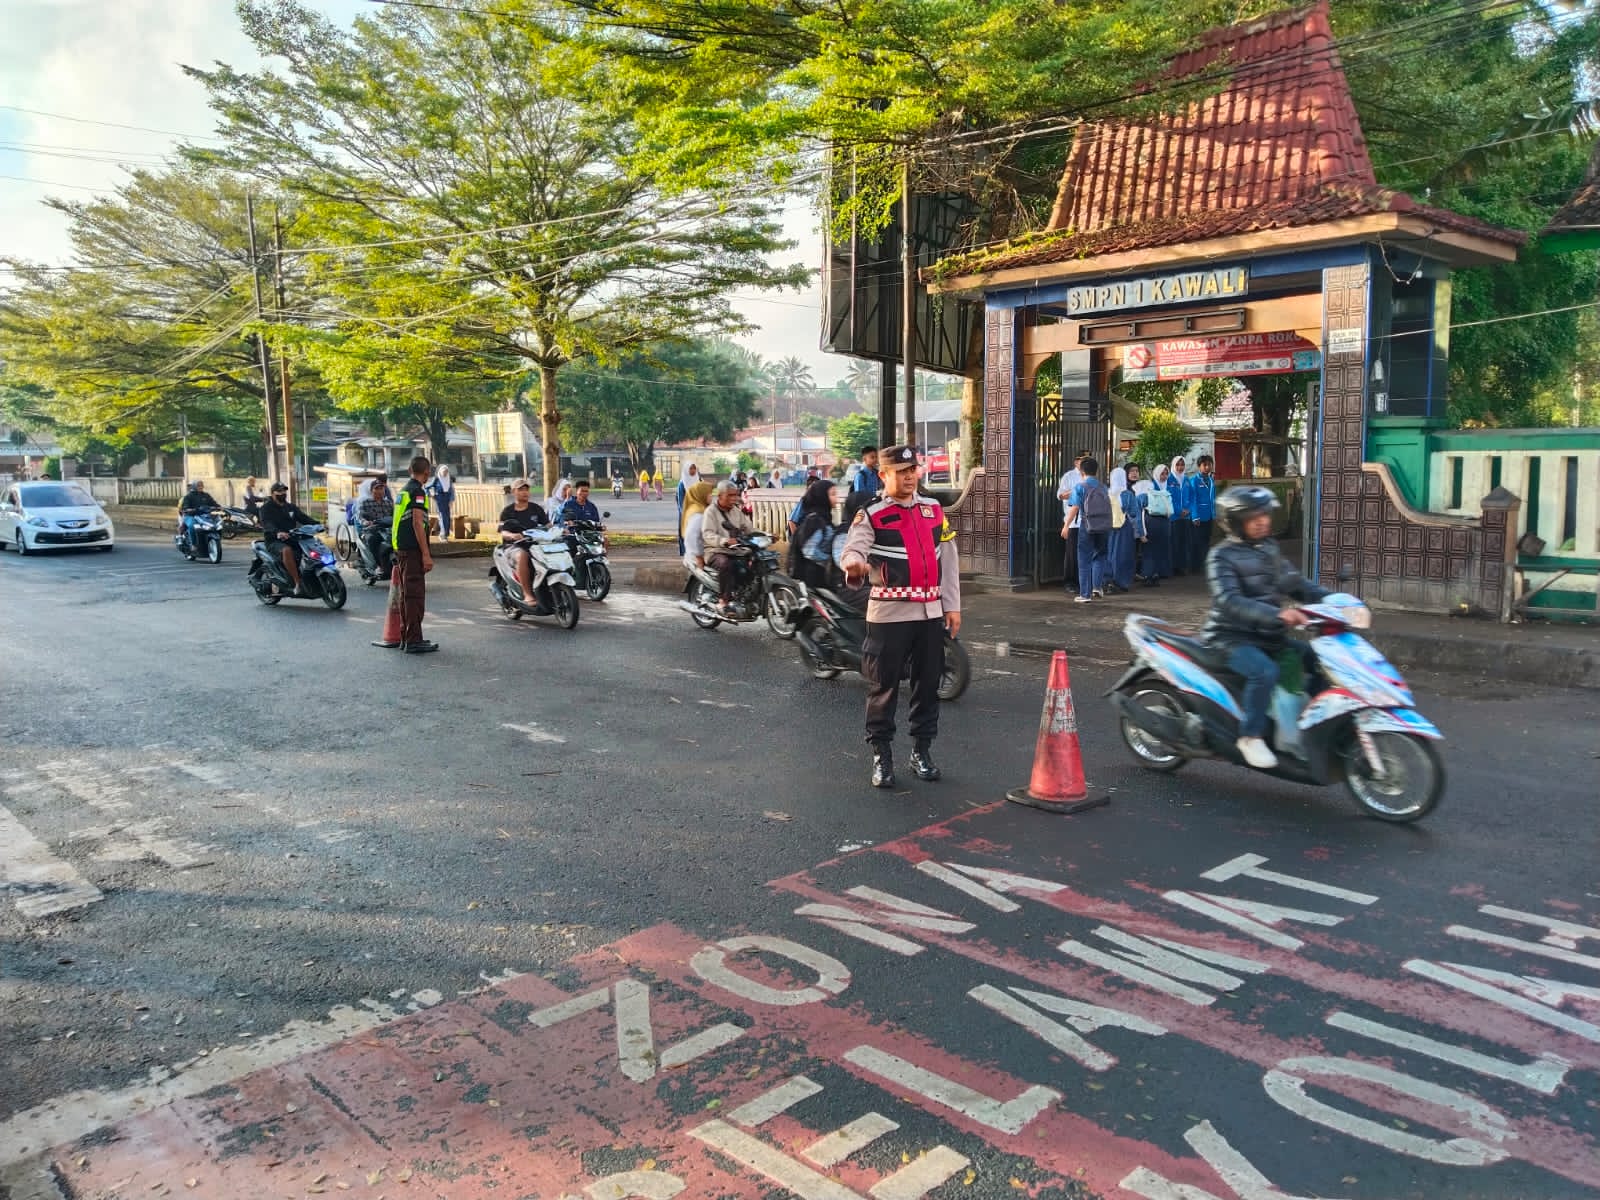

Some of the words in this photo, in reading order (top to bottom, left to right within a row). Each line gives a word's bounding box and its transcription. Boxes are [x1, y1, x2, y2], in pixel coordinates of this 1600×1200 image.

[1071, 284, 1126, 310] SMPN
[1134, 281, 1144, 303] 1
[1151, 269, 1247, 301] KAWALI
[1162, 338, 1220, 351] KAWASAN
[1223, 334, 1264, 348] TANPA
[527, 859, 1069, 1083] ZONA
